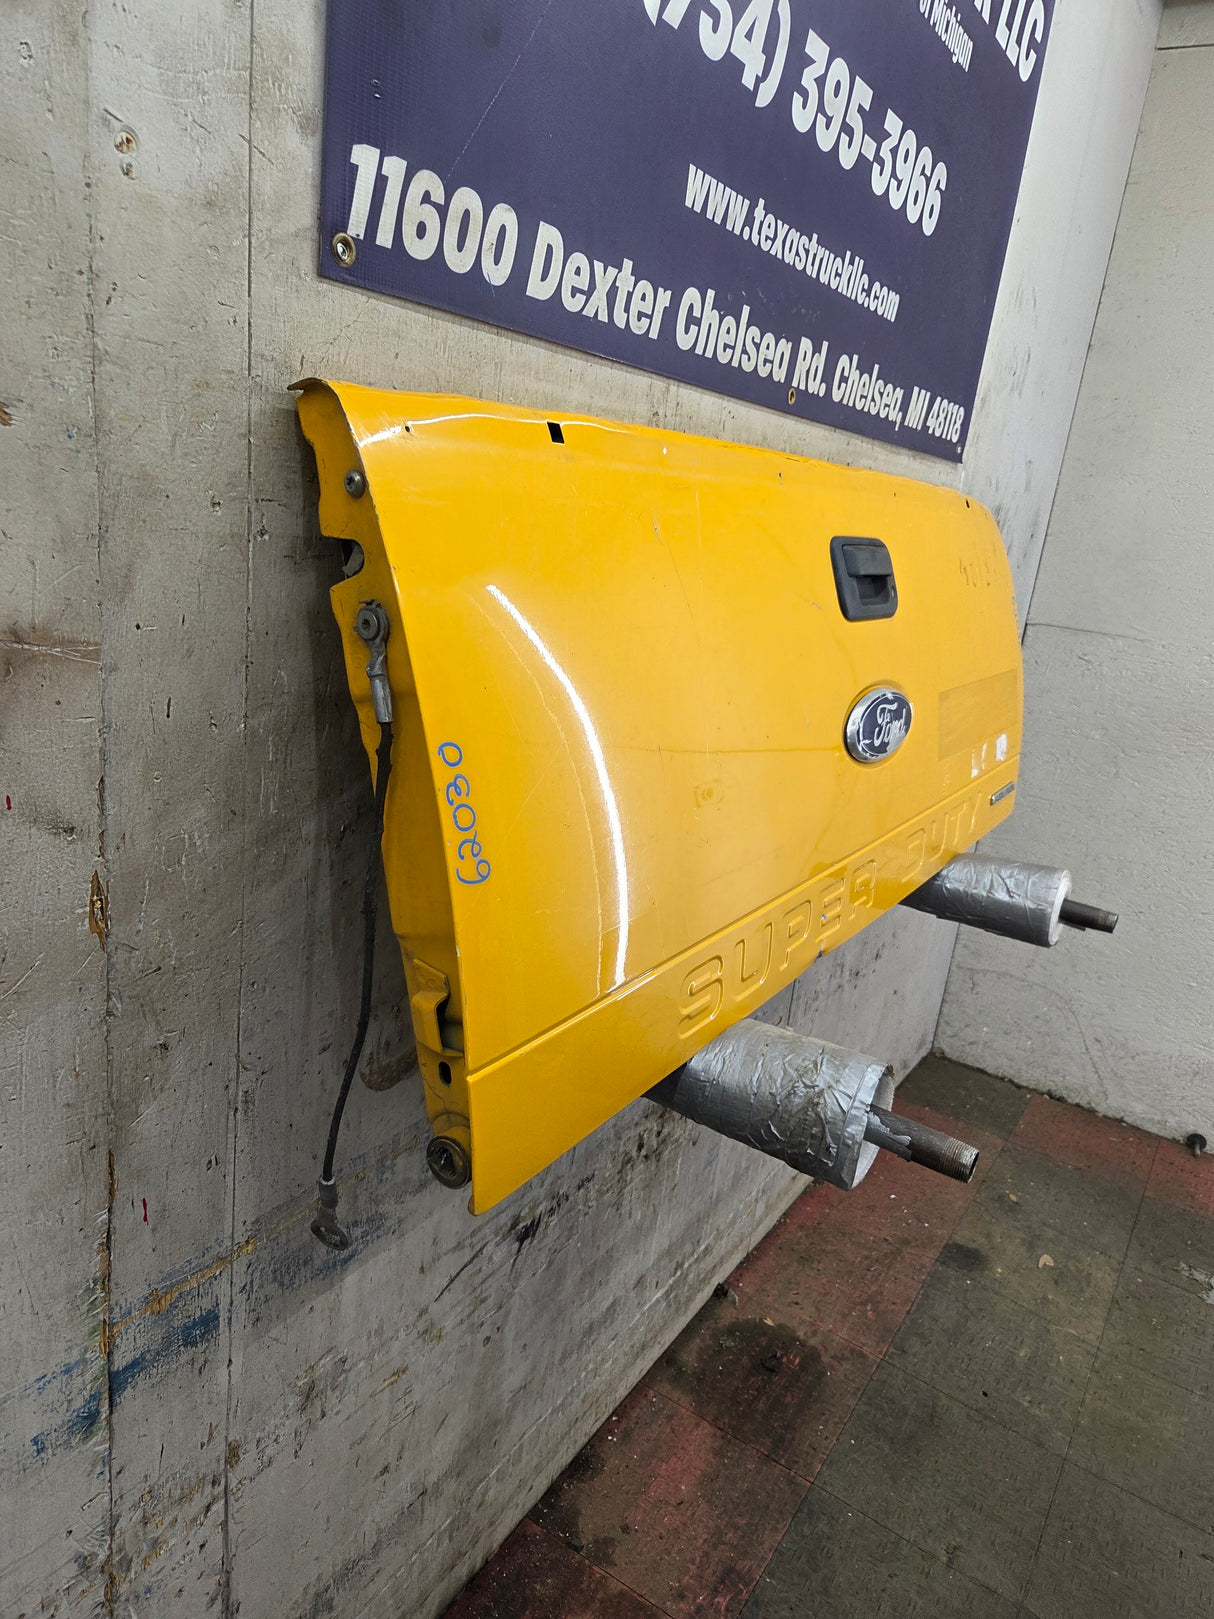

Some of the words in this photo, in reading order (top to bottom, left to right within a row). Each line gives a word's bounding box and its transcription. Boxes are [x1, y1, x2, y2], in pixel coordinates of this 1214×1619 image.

[930, 0, 974, 72] Michigan
[791, 28, 948, 237] 395-3966
[346, 143, 519, 287] 11600
[525, 220, 672, 340] Dexter
[676, 286, 793, 384] Chelsea
[791, 335, 829, 397] Rd.
[832, 354, 904, 431] Chelsea,
[904, 386, 931, 431] MI
[926, 396, 966, 443] 48118
[685, 163, 900, 323] www.texastruckllc.com
[873, 702, 906, 747] Ford
[437, 741, 491, 885] 62030
[678, 858, 878, 1040] SUPER
[900, 790, 982, 883] DUTY
